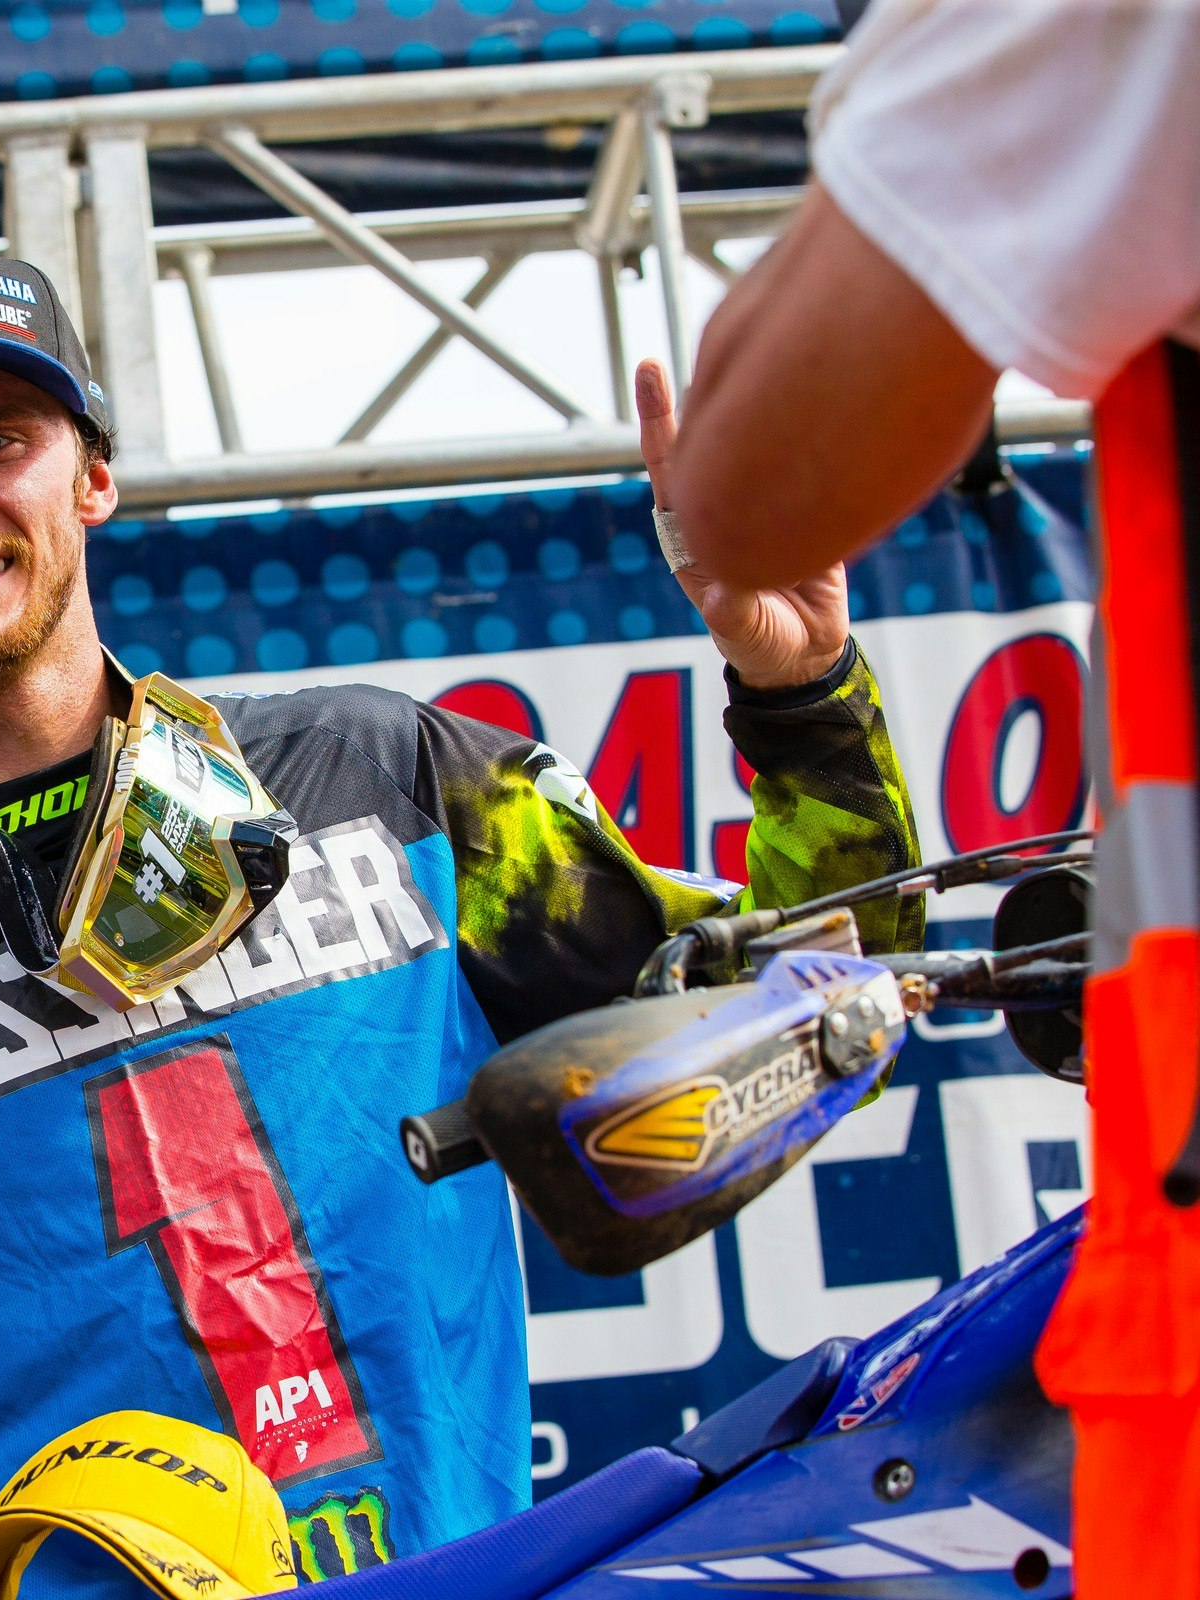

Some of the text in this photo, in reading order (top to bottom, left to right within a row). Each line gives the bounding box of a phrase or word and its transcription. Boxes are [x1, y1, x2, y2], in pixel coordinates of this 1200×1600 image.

[161, 799, 181, 840] 250
[168, 817, 187, 850] MX
[706, 1042, 819, 1132] CYCRA
[255, 1368, 334, 1434] AP1
[256, 1417, 339, 1451] CHAMPION
[272, 1427, 288, 1437] AMA
[291, 1409, 337, 1429] MOTOCROSS
[0, 1439, 228, 1508] DUNLOP
